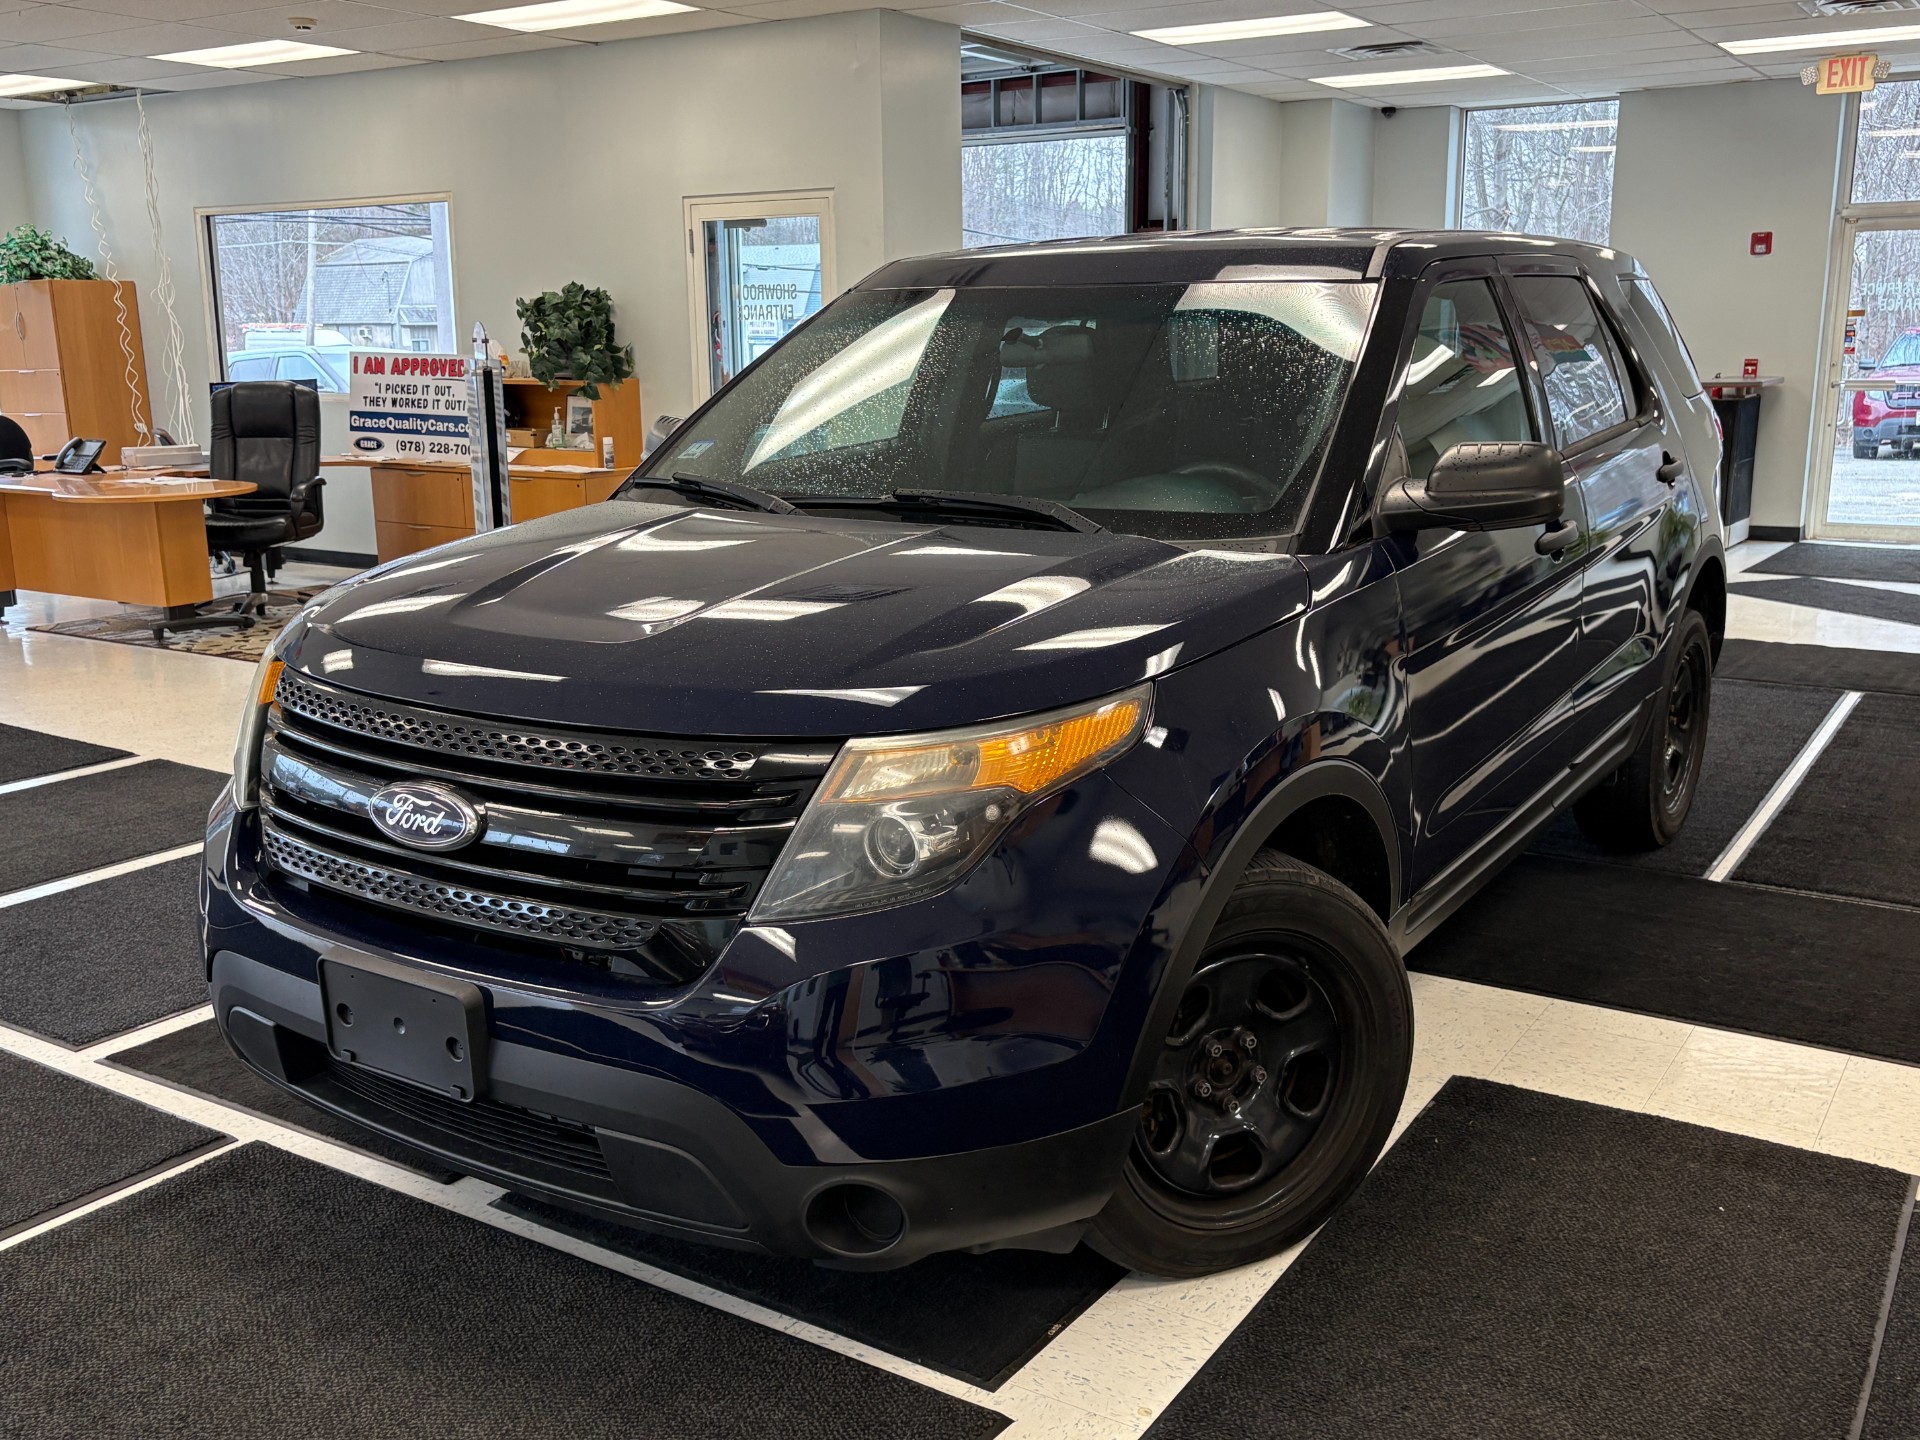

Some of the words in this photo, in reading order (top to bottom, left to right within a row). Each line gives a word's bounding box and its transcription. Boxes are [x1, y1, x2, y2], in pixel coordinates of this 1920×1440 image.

[1826, 56, 1869, 89] EXIT
[353, 356, 359, 374] I
[363, 356, 385, 375] AM
[390, 357, 465, 378] APPROVED
[385, 383, 418, 395] PICKED
[422, 384, 431, 396] IT
[434, 385, 455, 398] OUT,
[363, 396, 387, 408] THEY
[391, 397, 429, 409] WORKED
[432, 399, 441, 410] IT
[351, 415, 470, 434] GraceQualityCars.co
[360, 440, 377, 449] GRACE
[396, 439, 426, 454] (978)
[385, 793, 446, 835] Ford
